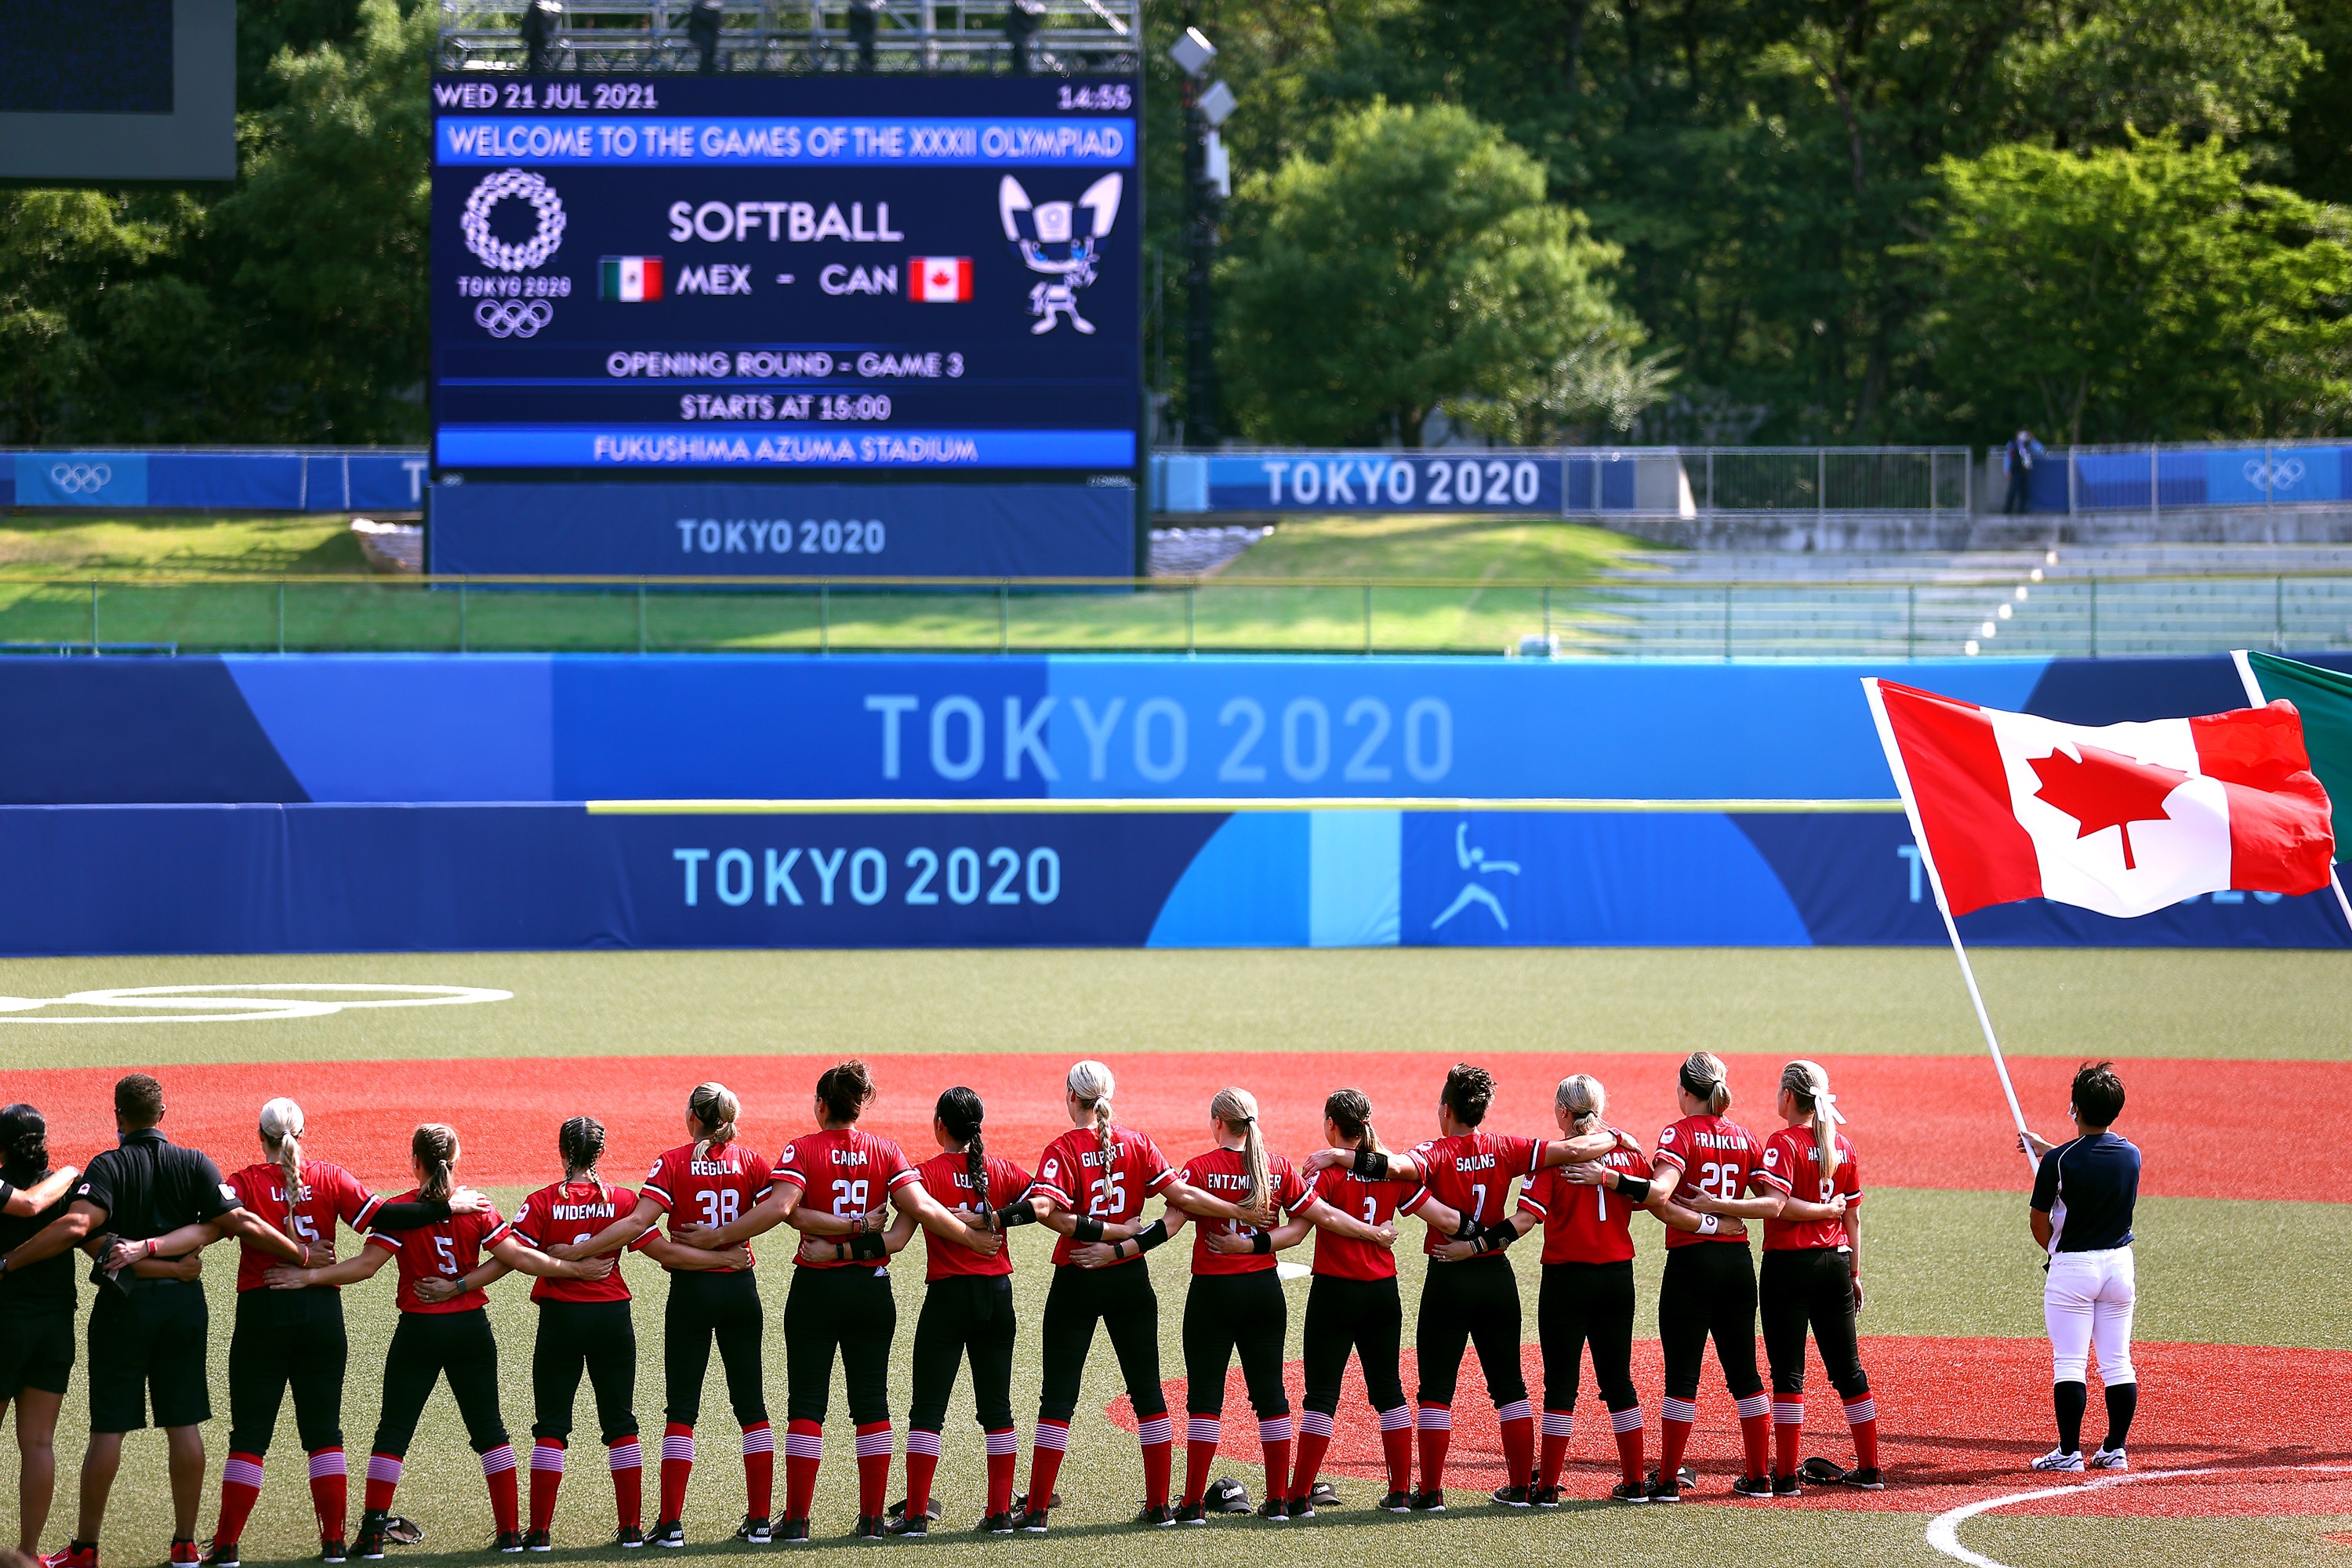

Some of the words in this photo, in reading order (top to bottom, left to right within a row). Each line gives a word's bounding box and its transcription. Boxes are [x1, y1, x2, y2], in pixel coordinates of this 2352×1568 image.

[434, 83, 499, 108] WED
[504, 83, 537, 108] 21
[541, 83, 590, 108] JUL
[593, 83, 659, 108] 2021
[1057, 85, 1133, 110] 14:55
[448, 125, 593, 158] WELCOME
[598, 126, 638, 158] TO
[642, 126, 695, 158] THE
[700, 126, 803, 158] GAMES
[807, 126, 849, 158] OF
[851, 126, 906, 158] THE
[909, 126, 978, 158] XXXII
[981, 126, 1123, 158] OLYMPIAD
[670, 201, 905, 243] SOFTBALL
[457, 276, 521, 298] TOKYO
[524, 276, 572, 298] 2020
[676, 264, 752, 296] MEX
[819, 264, 898, 296] CAN
[606, 350, 731, 378] OPENING
[735, 350, 833, 378] ROUND
[857, 351, 942, 378] GAME
[946, 351, 965, 378] 3
[680, 394, 776, 420] STARTS
[778, 394, 815, 420] AT
[818, 394, 892, 421] 15:00
[593, 435, 752, 463] FUKUSHIMA
[754, 436, 858, 463] AZUMA
[860, 436, 979, 463] STADIUM
[1263, 459, 1417, 505] TOKYO
[1426, 459, 1540, 505] 2020
[676, 518, 793, 554] TOKYO
[799, 518, 886, 554] 2020
[863, 695, 1189, 782] TOKYO
[1217, 696, 1454, 782] 2020
[673, 847, 887, 906] TOKYO
[905, 846, 1061, 906] 2020
[1694, 1131, 1748, 1150] FRANKLIN
[691, 1160, 739, 1176] REGULA
[831, 1149, 868, 1167] CAIRA
[1088, 1171, 1126, 1217] 25
[1207, 1173, 1282, 1190] ENTZMIER
[1700, 1162, 1740, 1200] 26
[553, 1203, 615, 1221] WIDEMAN
[695, 1189, 739, 1230] 38
[832, 1179, 869, 1219] 29
[1363, 1196, 1377, 1226] 3
[1472, 1184, 1486, 1221] 7
[434, 1236, 458, 1275] 5
